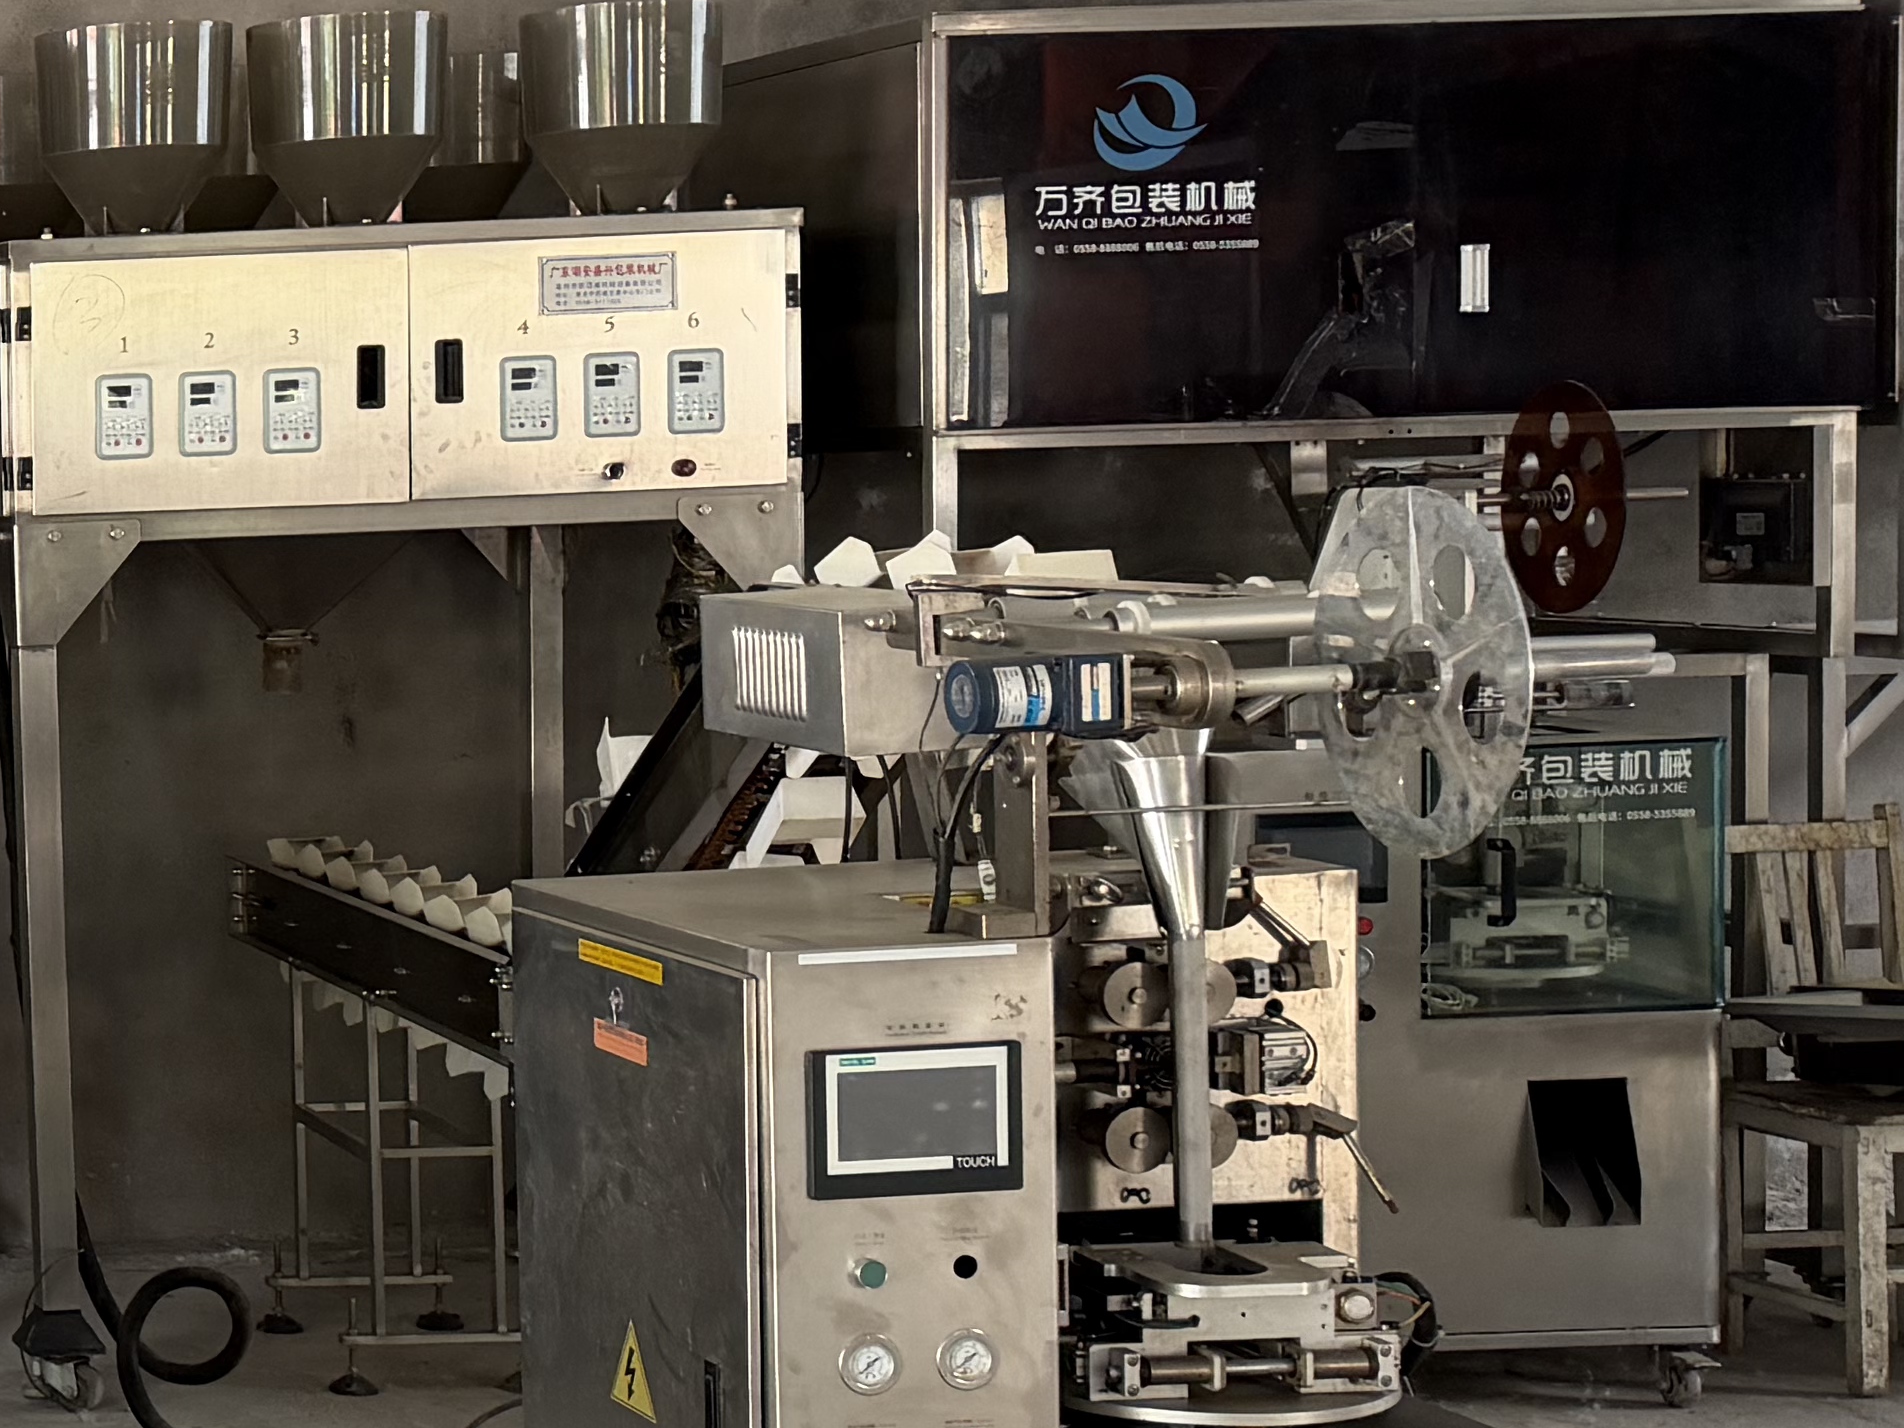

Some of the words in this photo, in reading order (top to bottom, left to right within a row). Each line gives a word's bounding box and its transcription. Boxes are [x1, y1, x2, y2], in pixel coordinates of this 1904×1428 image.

[1034, 179, 1257, 216] 万齐包装机械
[1037, 217, 1079, 231] WAN
[1082, 218, 1098, 230] QI
[1101, 216, 1138, 229] BAO
[1140, 214, 1212, 228] ZHUANG
[1213, 214, 1224, 226] JI
[1226, 213, 1253, 225] XIE
[119, 336, 129, 353] 1
[203, 332, 215, 349] 2
[288, 328, 300, 346] 3
[516, 318, 530, 335] 4
[603, 315, 616, 333] 5
[687, 311, 700, 329] 6
[1511, 788, 1528, 801] QI
[1532, 786, 1568, 800] BAO
[1572, 783, 1646, 799] ZHUANG
[1649, 782, 1659, 796] JI
[1662, 781, 1689, 794] XIE
[956, 1155, 996, 1169] TOUCH
